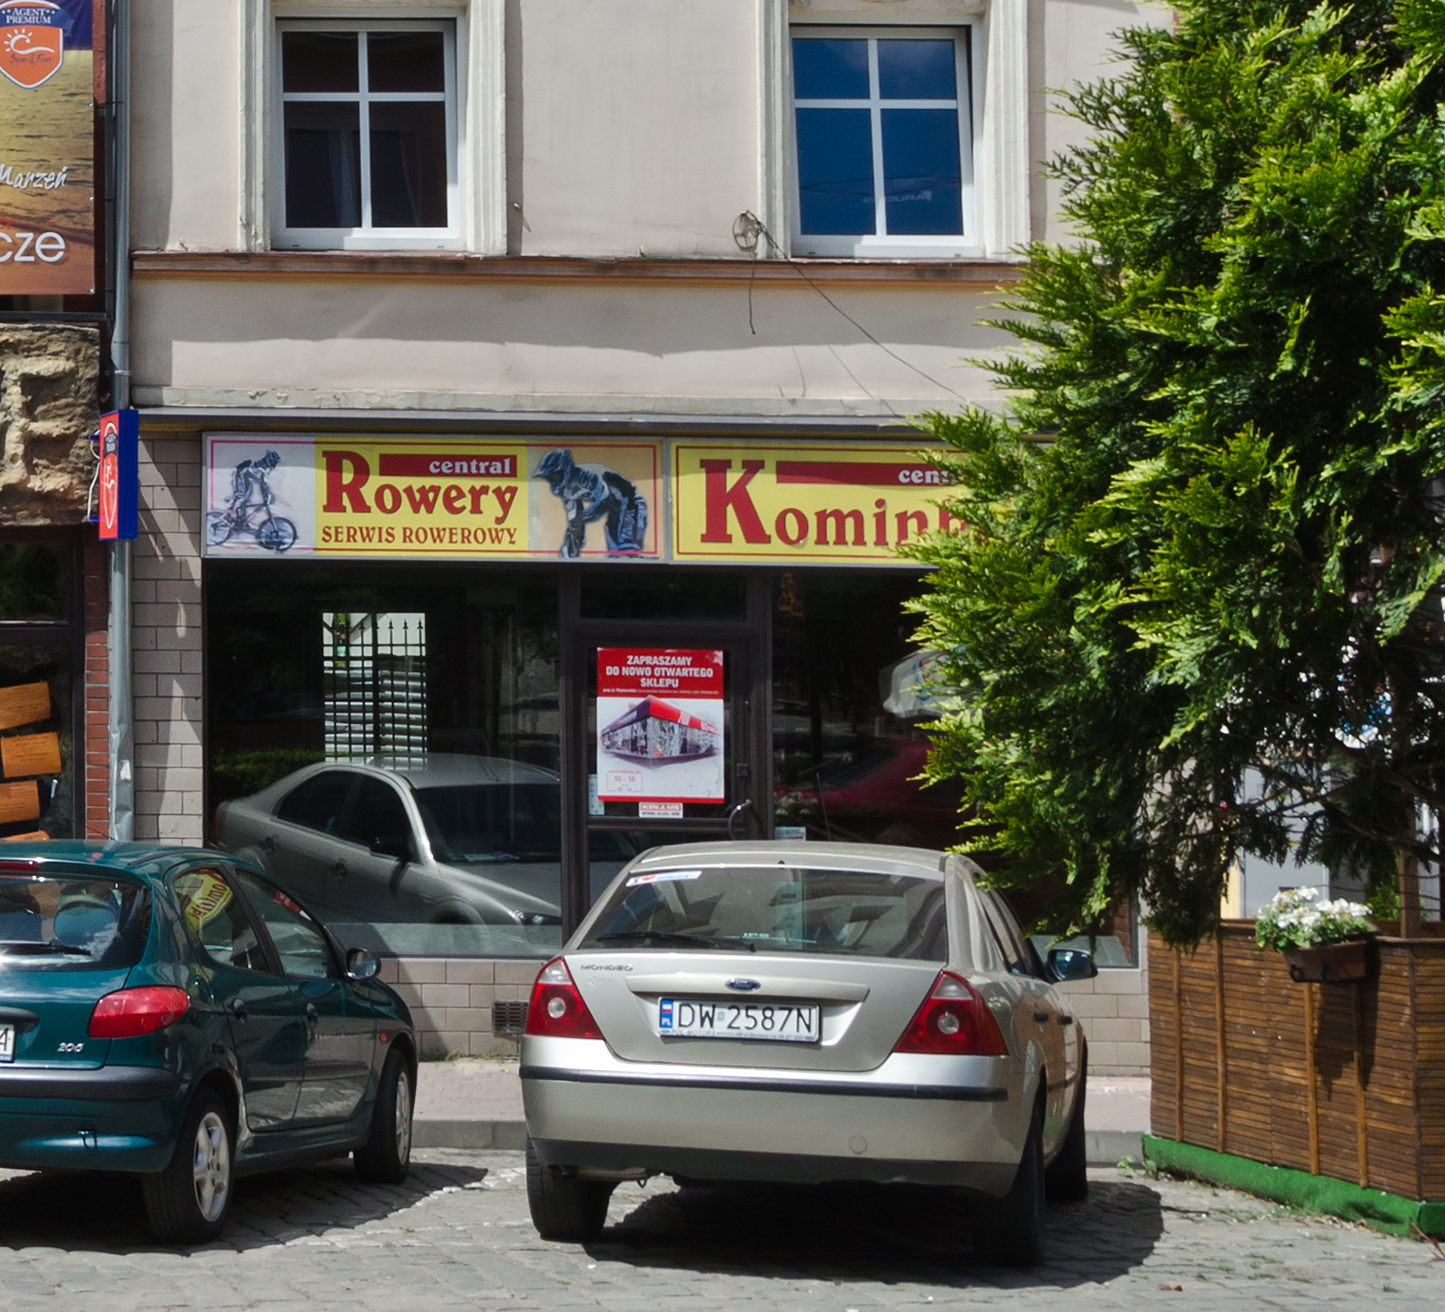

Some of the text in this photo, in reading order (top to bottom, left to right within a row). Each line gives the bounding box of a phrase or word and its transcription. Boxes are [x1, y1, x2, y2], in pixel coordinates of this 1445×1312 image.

[12, 7, 46, 17] AGENT
[5, 16, 51, 24] PREMIUM
[428, 457, 511, 475] central
[321, 449, 519, 525] Rowery
[321, 525, 518, 545] SERWIS ROWEROWY
[626, 655, 693, 666] ZAPRASZAMY
[605, 666, 714, 678] DO NOWO OTWARTEGO
[640, 677, 679, 688] SKLEPU
[677, 1003, 718, 1028] DW
[726, 1004, 813, 1033] 2587N
[57, 1042, 84, 1053] 206
